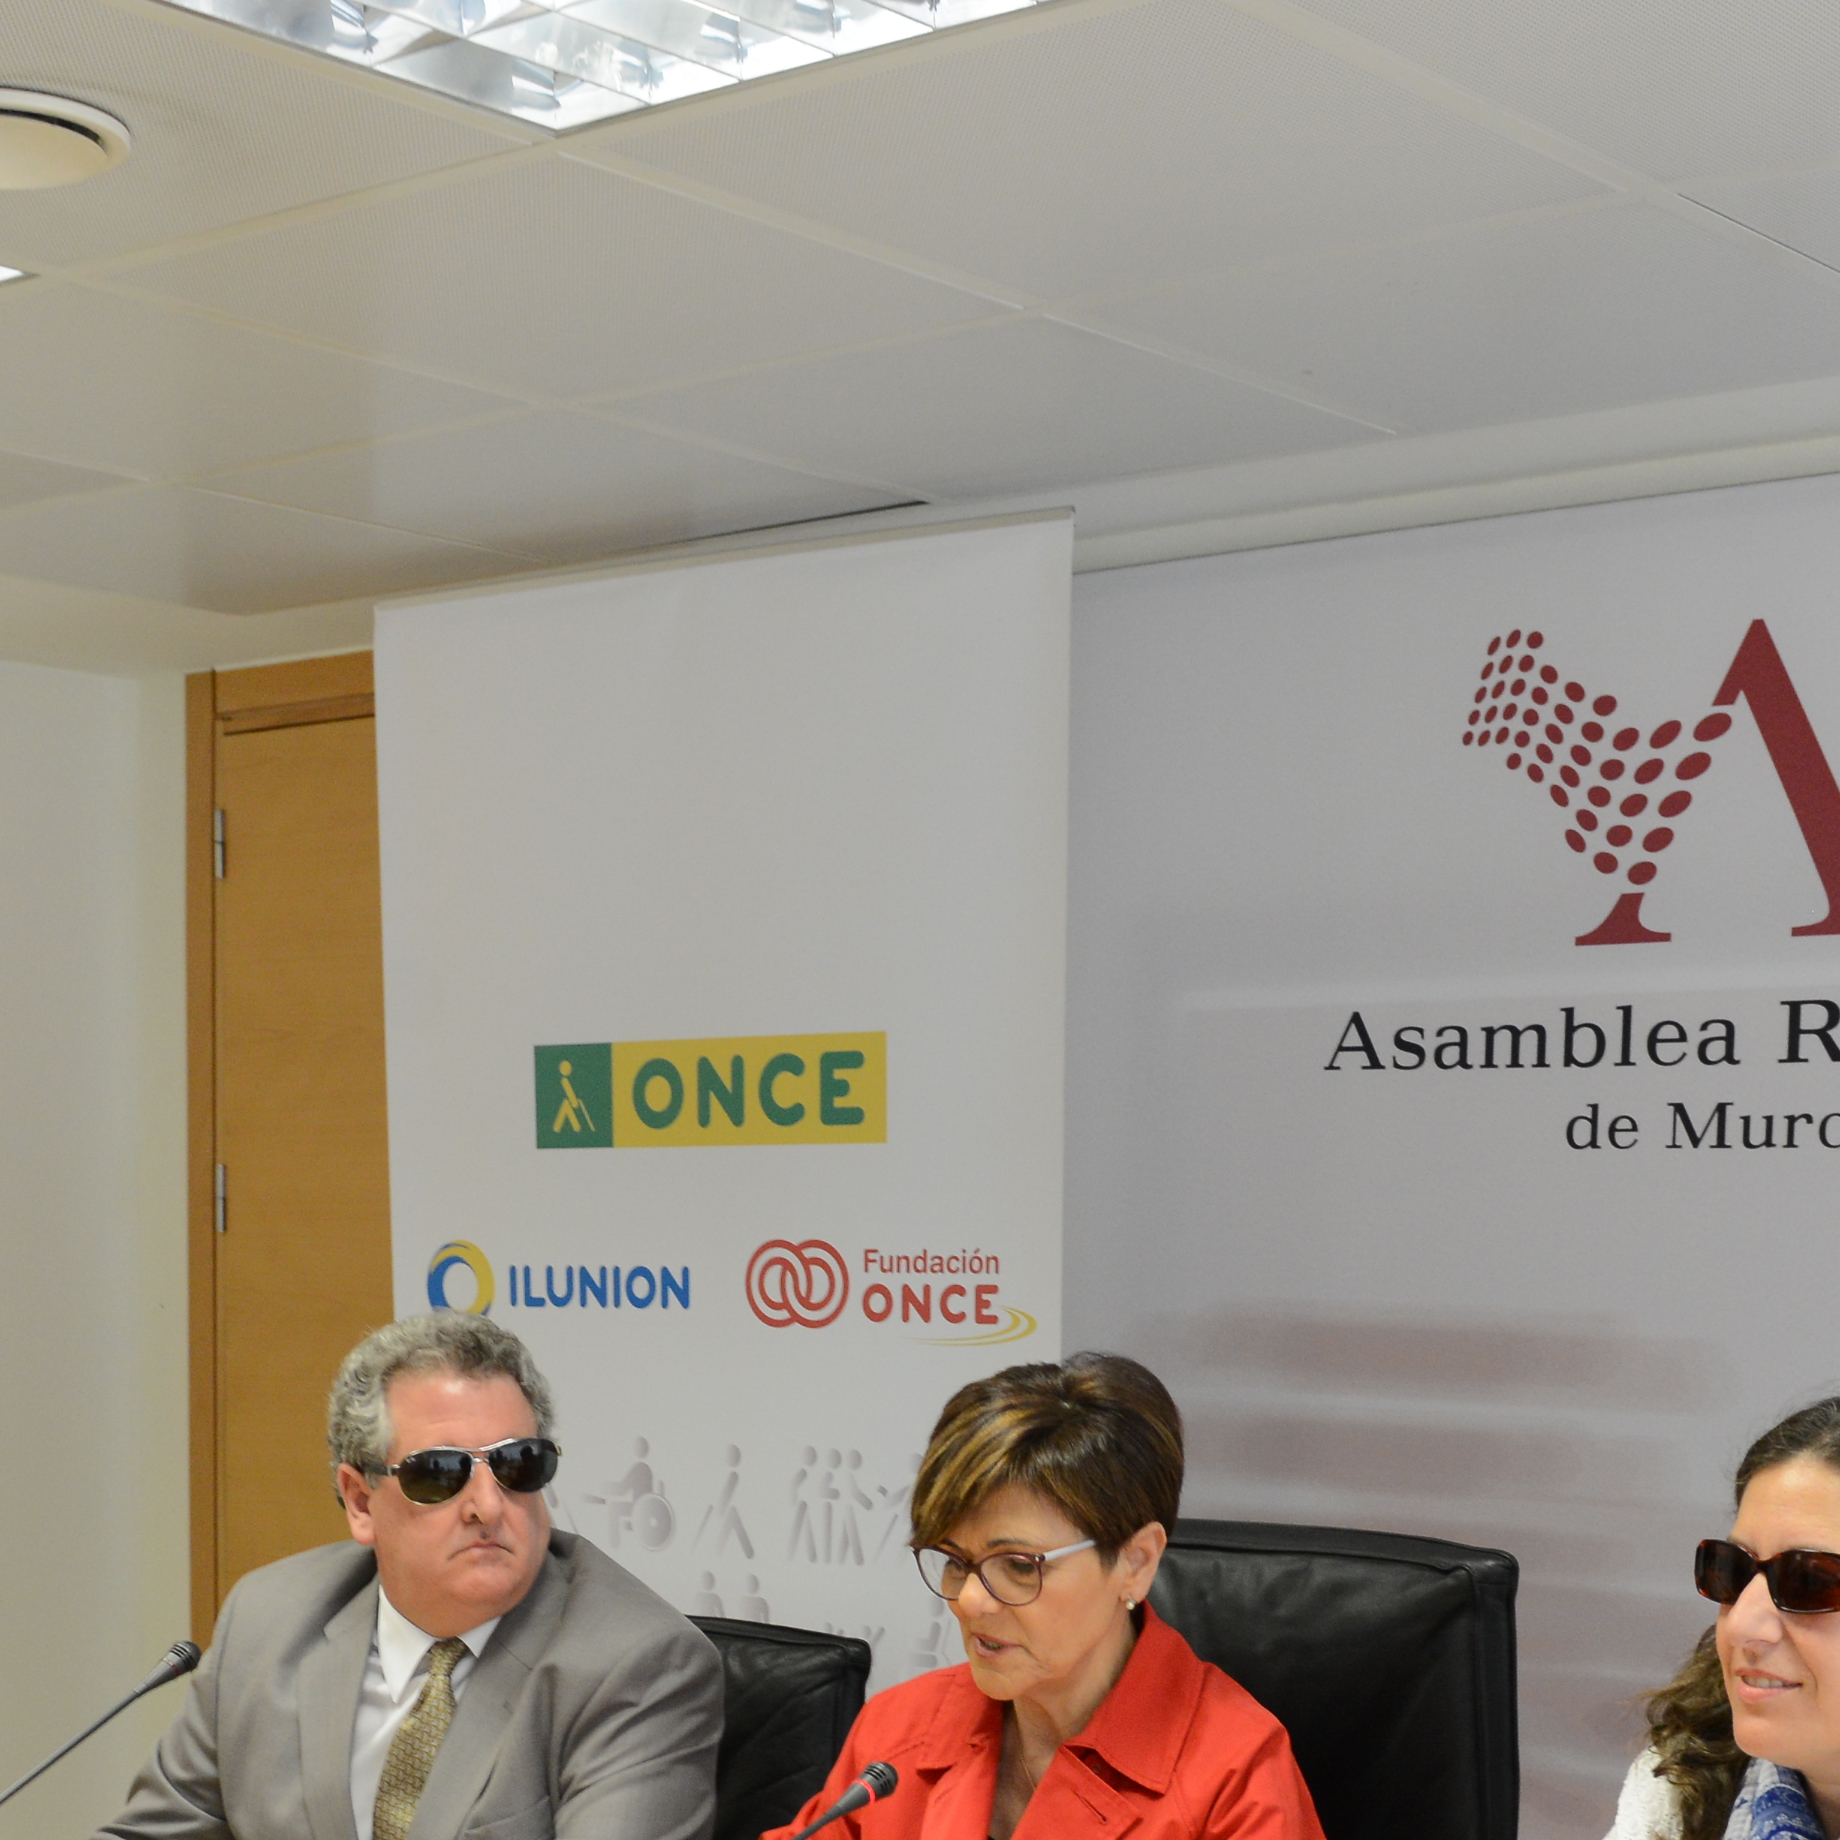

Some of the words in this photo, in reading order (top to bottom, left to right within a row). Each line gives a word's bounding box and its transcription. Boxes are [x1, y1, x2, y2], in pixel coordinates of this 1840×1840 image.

[1323, 1005, 1742, 1072] Asamblea
[632, 1050, 866, 1130] ONCE
[1565, 1103, 1640, 1152] de
[862, 1248, 1001, 1275] Fundación
[508, 1264, 691, 1311] ILUNION
[862, 1283, 1001, 1325] ONCE
